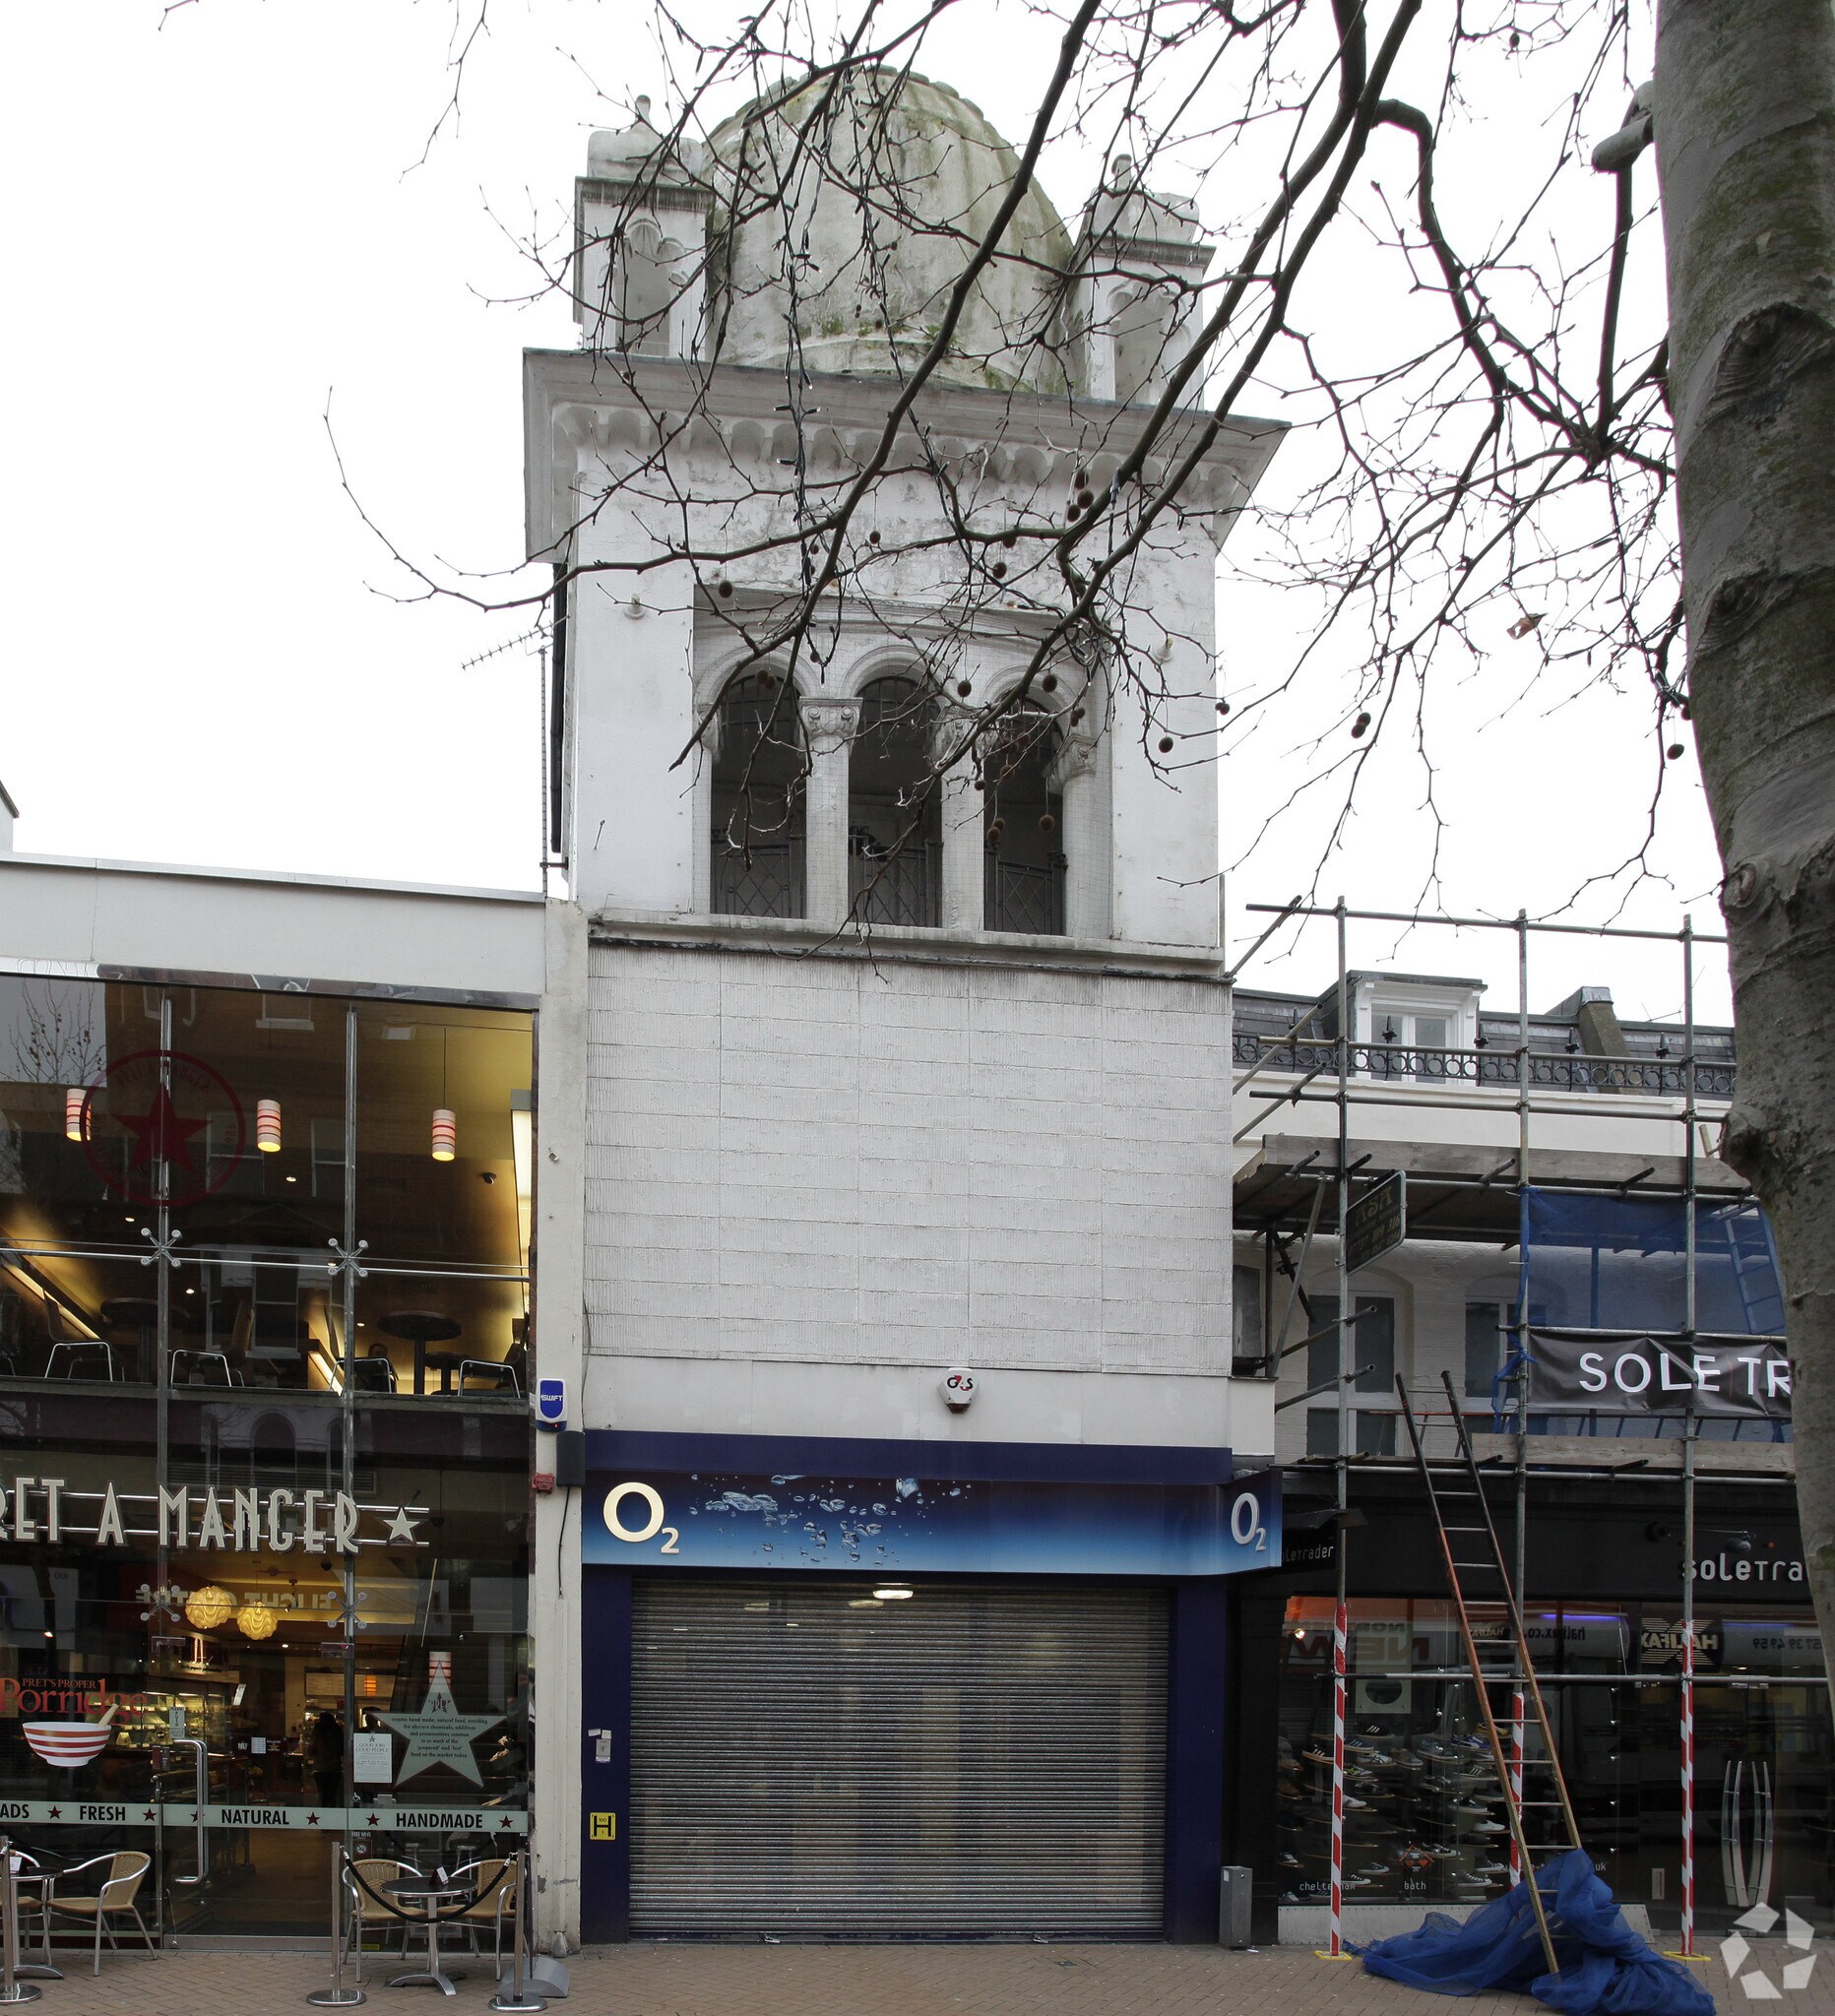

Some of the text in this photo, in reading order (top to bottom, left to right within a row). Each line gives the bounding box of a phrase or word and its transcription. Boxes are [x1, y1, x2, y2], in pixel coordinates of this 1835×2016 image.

[947, 1374, 974, 1391] G4S
[1579, 1353, 1721, 1393] SOLE
[97, 1480, 126, 1545] A
[158, 1483, 360, 1555] MANGER
[602, 1481, 679, 1554] O2
[1231, 1492, 1267, 1551] O2
[0, 1677, 148, 1726] Porridge
[23, 1678, 96, 1689] PRET'S PROPER
[79, 1805, 126, 1821] FRESH
[221, 1809, 289, 1825] NATURAL
[396, 1812, 483, 1829] HANDMADE
[1404, 1880, 1426, 1891] bath
